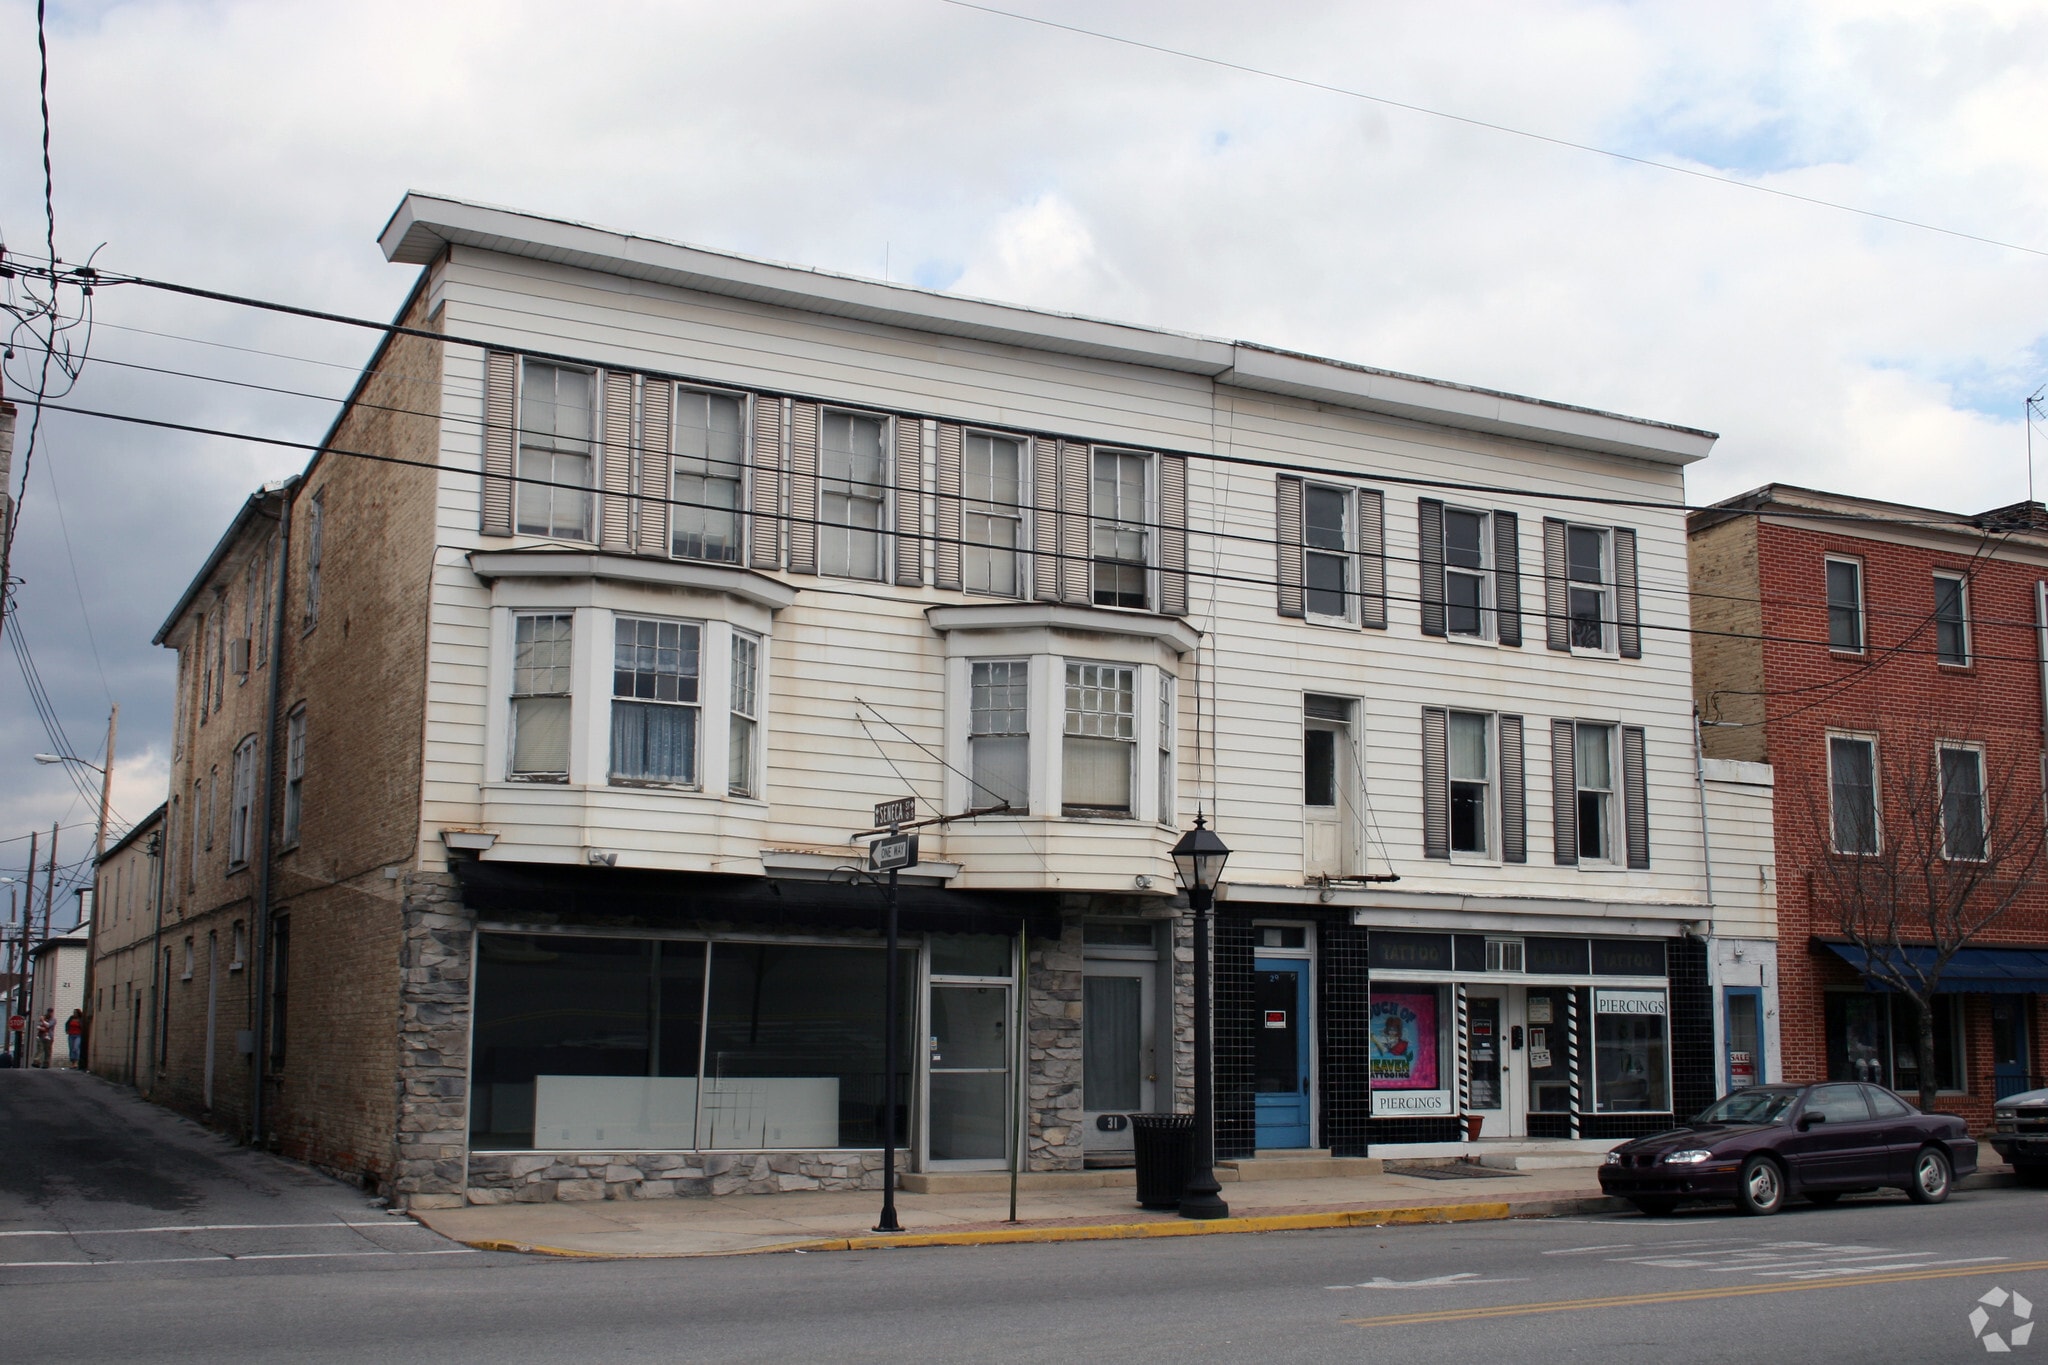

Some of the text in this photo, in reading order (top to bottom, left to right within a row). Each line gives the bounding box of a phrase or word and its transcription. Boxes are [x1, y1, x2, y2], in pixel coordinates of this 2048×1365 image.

[880, 803, 903, 823] SENECA
[881, 844, 905, 859] ONE WAY
[1383, 944, 1438, 961] TATTOO
[1599, 999, 1665, 1014] PIERCINGS
[1400, 1007, 1416, 1023] OF
[1380, 1097, 1442, 1110] PIERCINGS
[1107, 1117, 1118, 1129] 31
